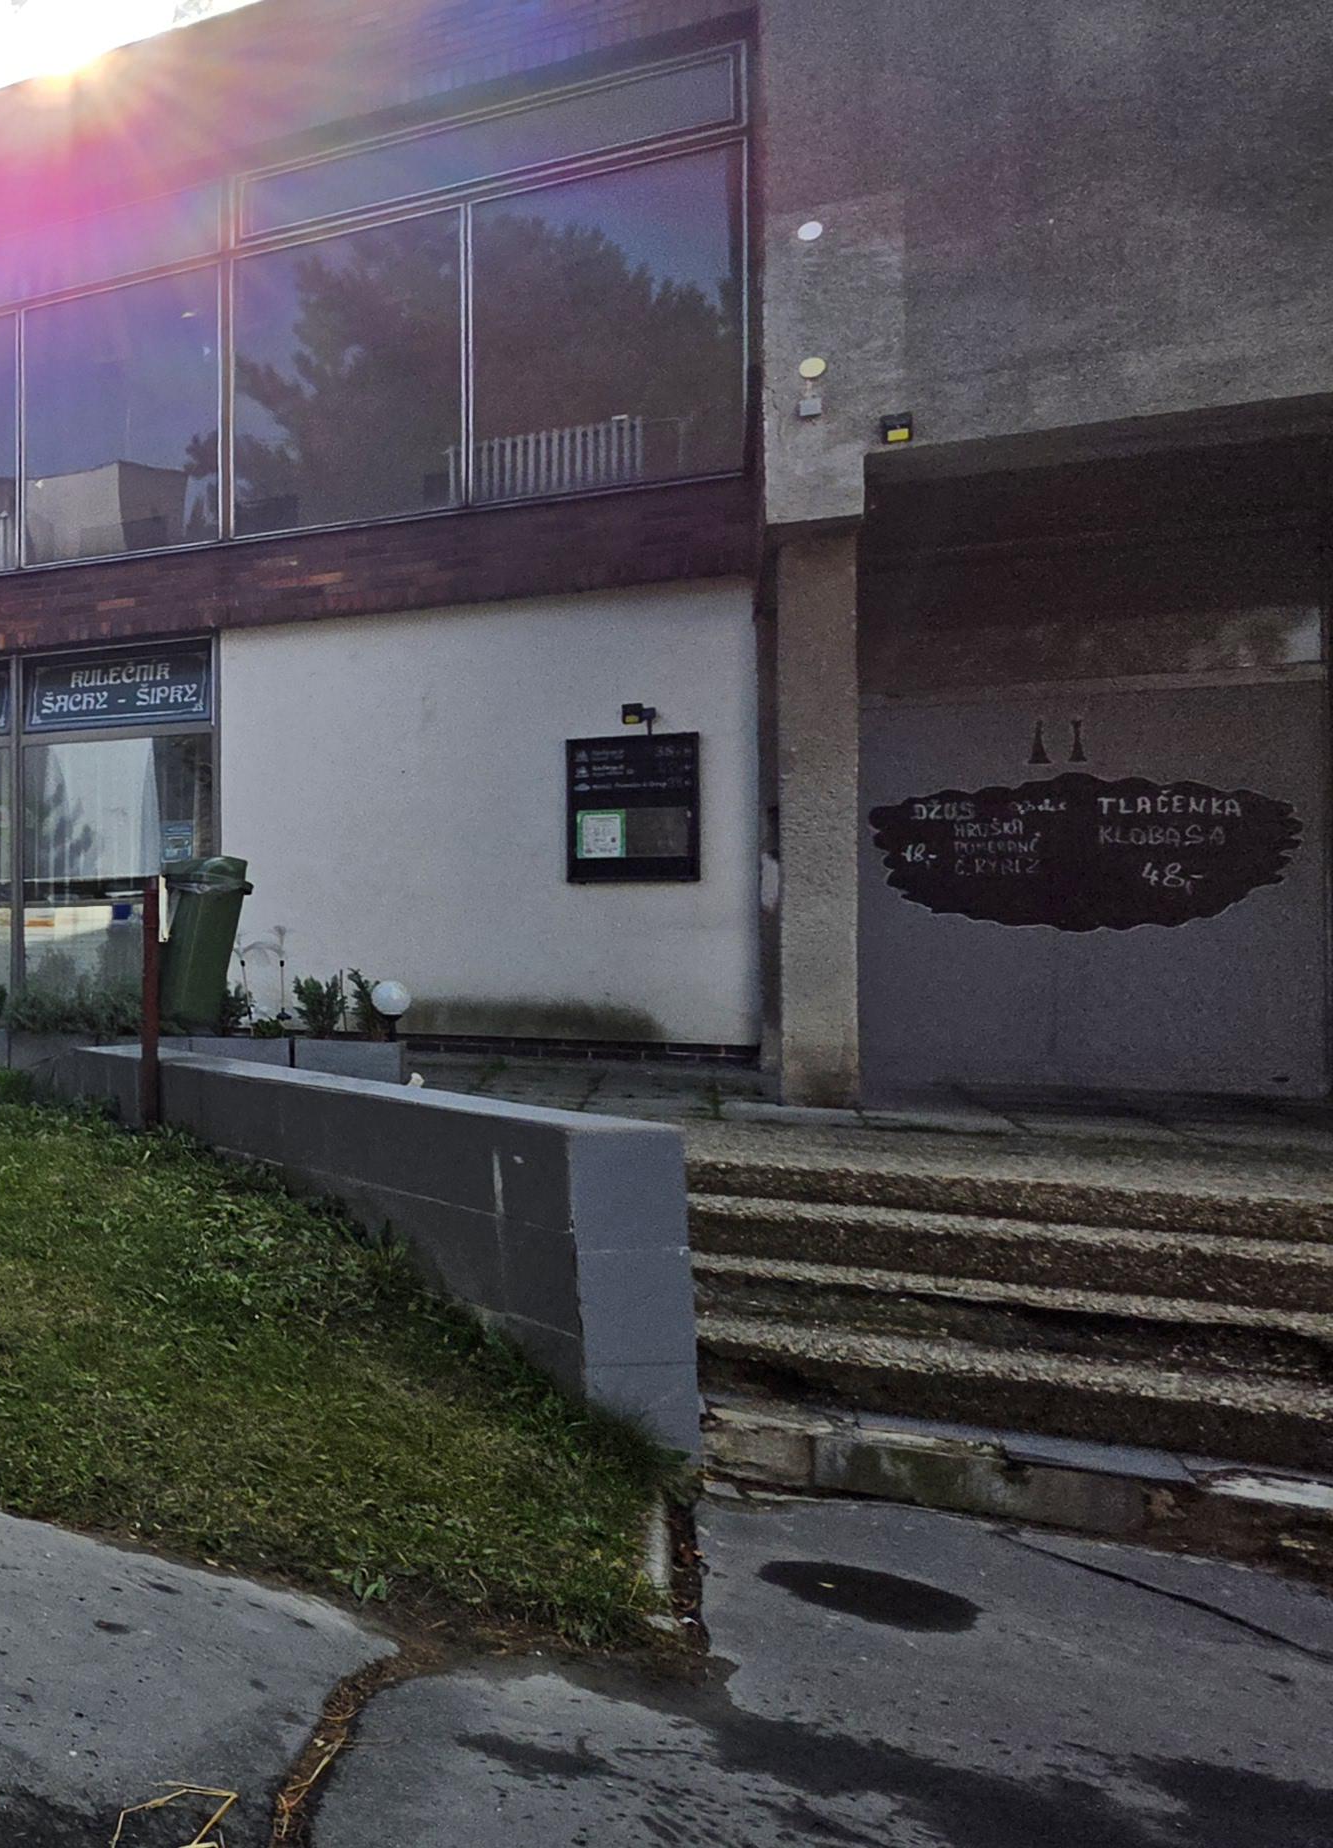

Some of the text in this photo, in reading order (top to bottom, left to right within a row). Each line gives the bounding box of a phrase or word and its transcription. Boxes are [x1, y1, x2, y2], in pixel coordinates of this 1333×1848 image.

[70, 658, 171, 689] KULEČNÍK
[135, 682, 199, 707] ŠIPKY
[1097, 789, 1242, 817] TLAČENKA
[953, 817, 1024, 838] HRUŠKA
[1099, 824, 1226, 847] KLOBASA
[1142, 862, 1204, 895] 48,-
